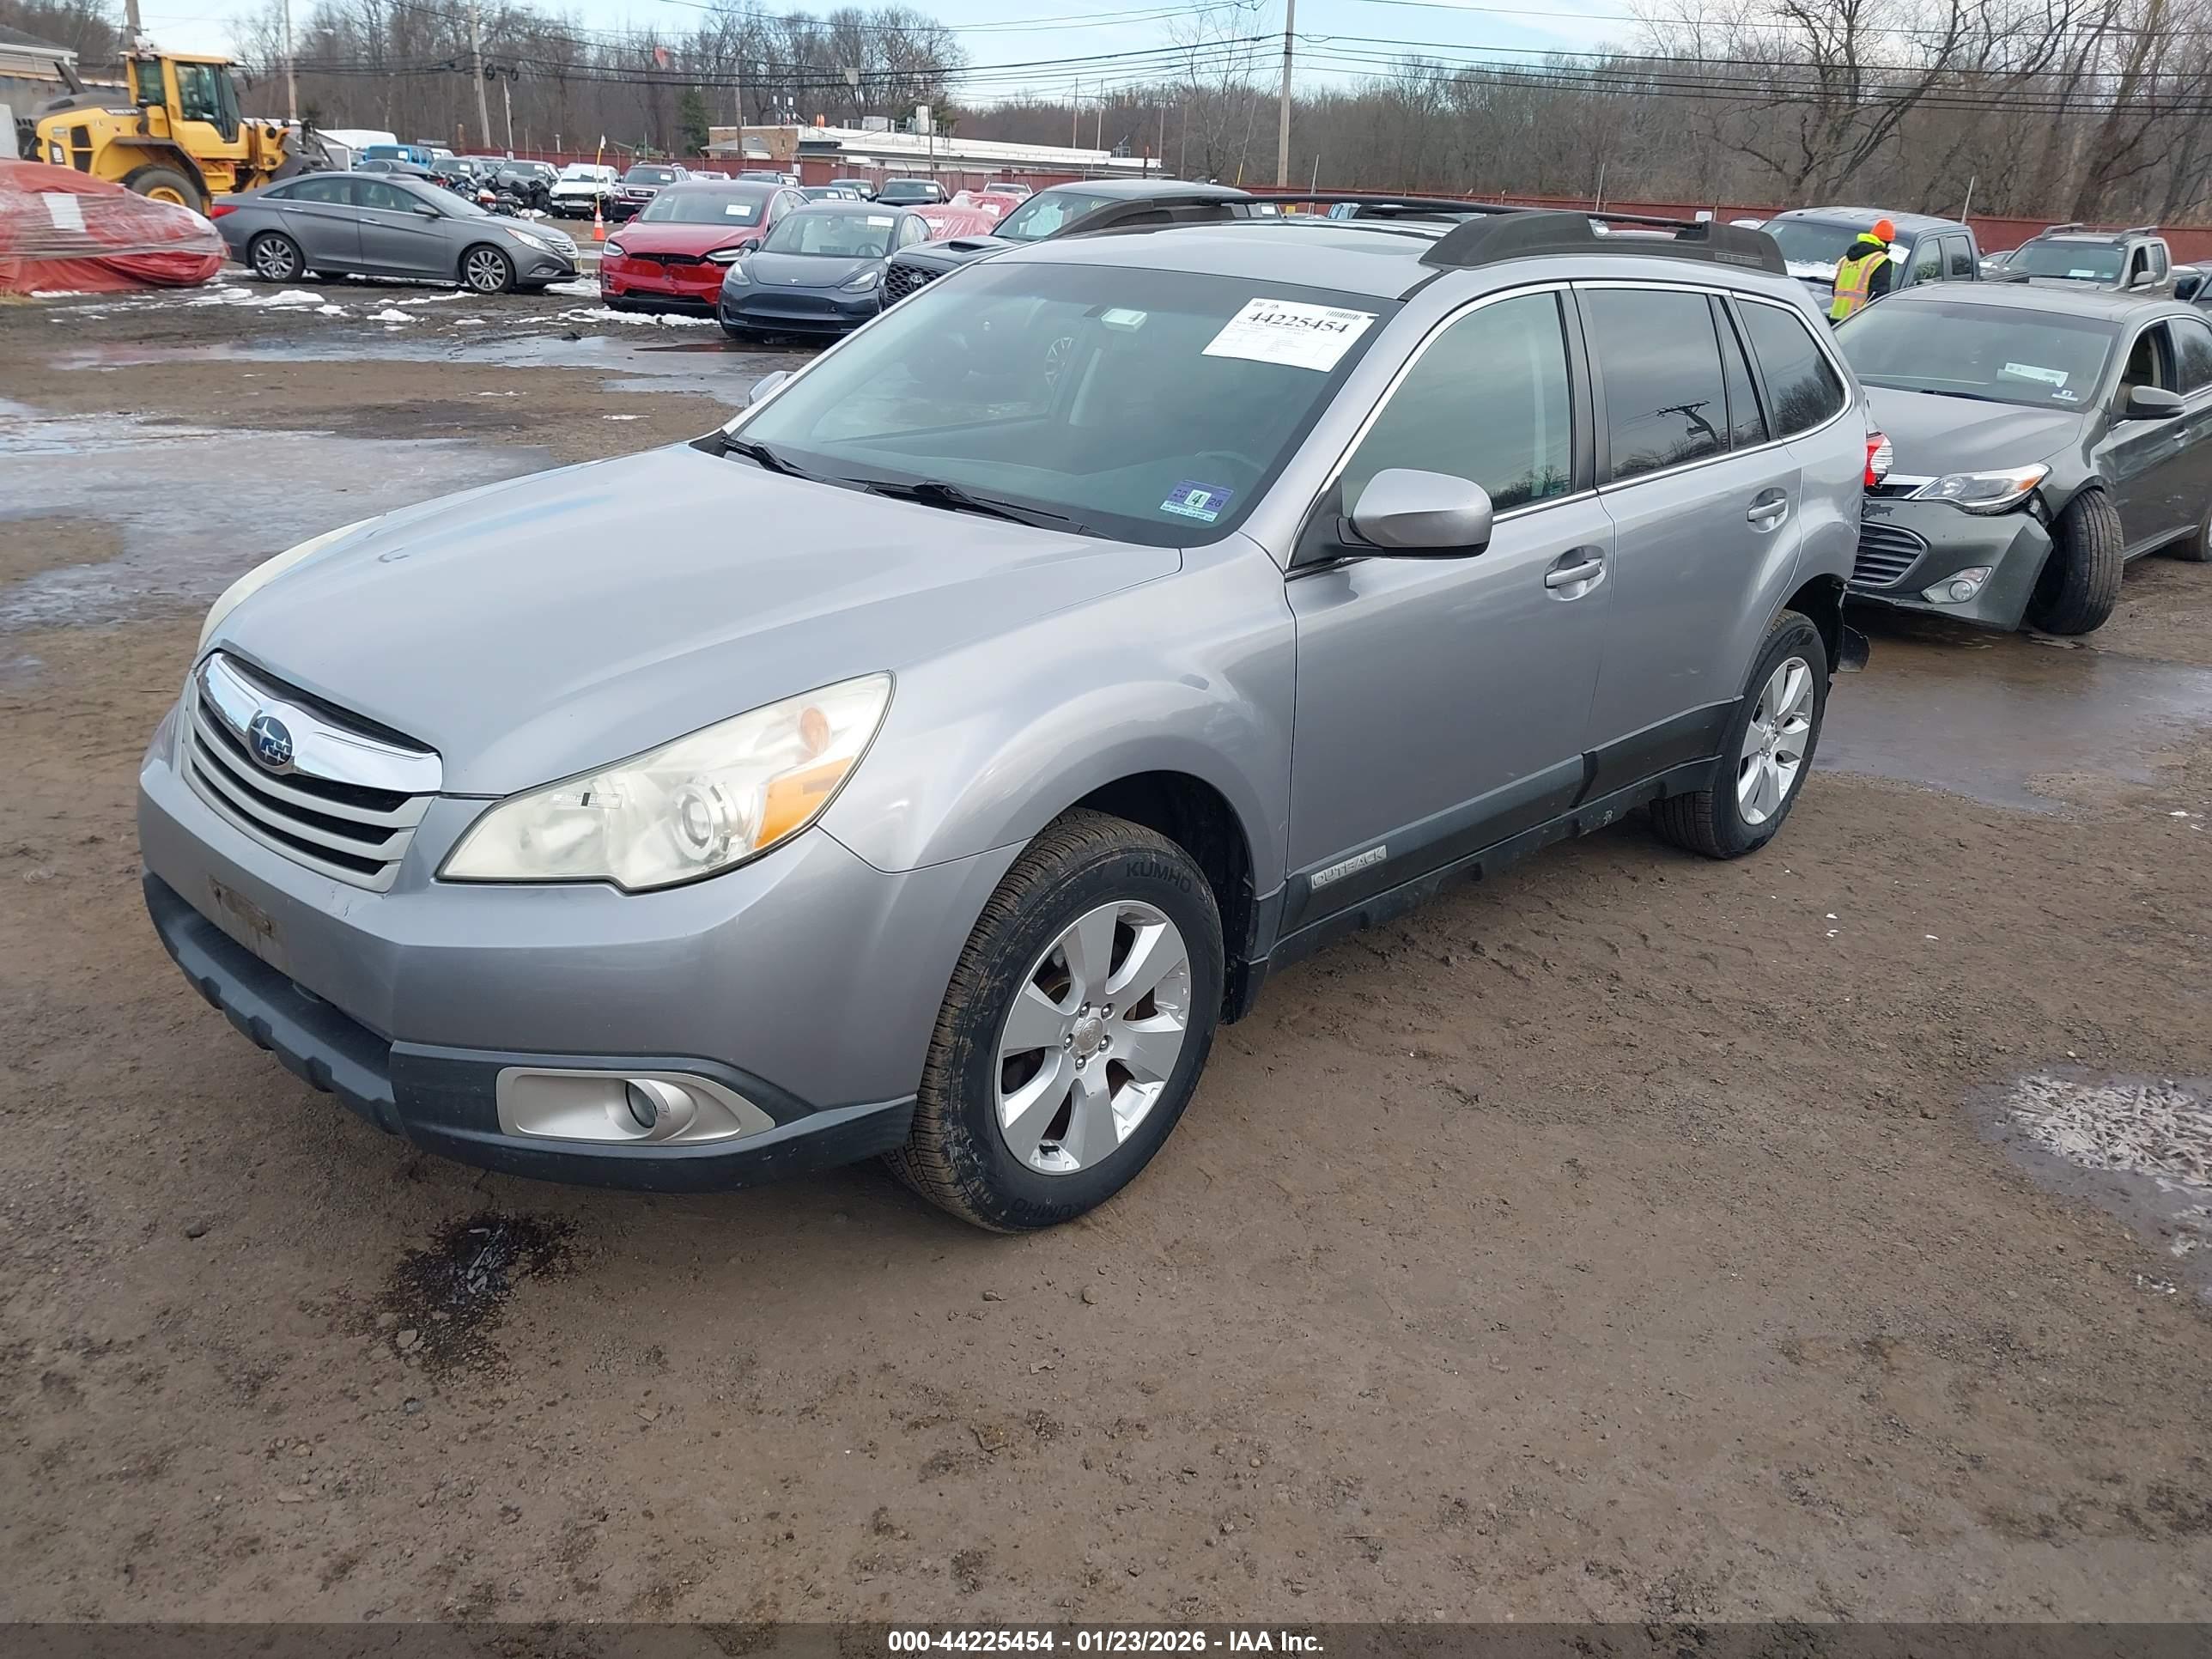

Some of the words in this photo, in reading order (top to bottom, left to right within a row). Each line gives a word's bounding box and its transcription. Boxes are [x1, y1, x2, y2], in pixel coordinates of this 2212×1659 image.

[1248, 312, 1350, 334] 44225454
[1173, 489, 1188, 498] 20
[1192, 494, 1204, 505] 4
[1208, 498, 1224, 507] 26
[1126, 861, 1192, 894] KUMHO
[1312, 847, 1383, 887] OUTBACK
